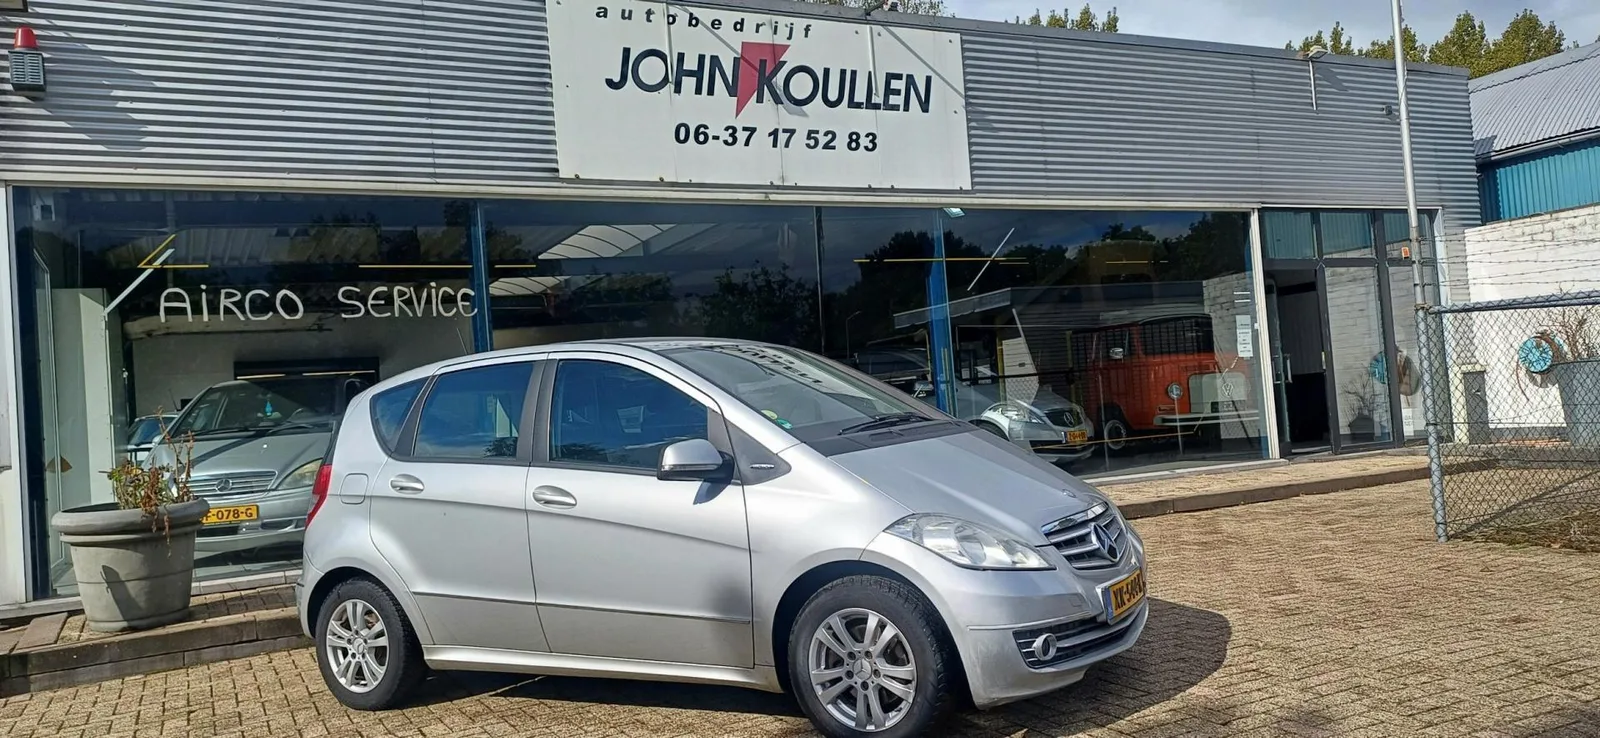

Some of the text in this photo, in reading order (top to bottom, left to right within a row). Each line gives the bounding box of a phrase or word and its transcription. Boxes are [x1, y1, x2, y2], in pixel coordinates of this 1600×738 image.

[595, 5, 812, 41] autobedrijf
[604, 46, 932, 114] JOHN KOULLEN
[674, 122, 879, 153] 06-37 17 52 83
[203, 507, 254, 521] F-078-G
